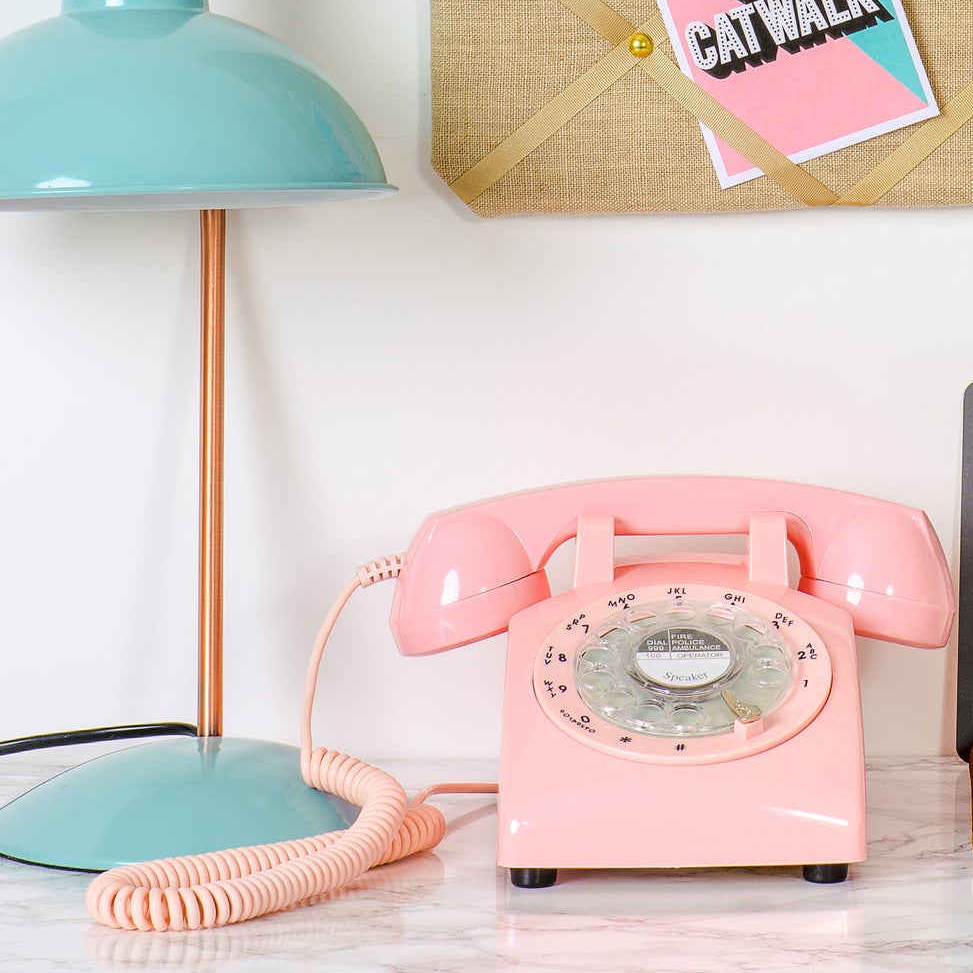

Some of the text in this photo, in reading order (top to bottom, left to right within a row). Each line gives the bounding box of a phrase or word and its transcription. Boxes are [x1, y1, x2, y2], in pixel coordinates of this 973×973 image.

[666, 587, 687, 595] JKL
[607, 593, 636, 607] MNO
[724, 593, 746, 604] GHI
[775, 612, 794, 627] DEF
[582, 624, 590, 634] 7
[544, 646, 554, 666] TUV
[797, 650, 807, 660] 2
[806, 643, 818, 660] ABC
[558, 653, 567, 663] 8
[662, 671, 708, 682] Speaker
[543, 679, 557, 698] WXY
[558, 684, 567, 693] 9
[803, 679, 809, 688] 1
